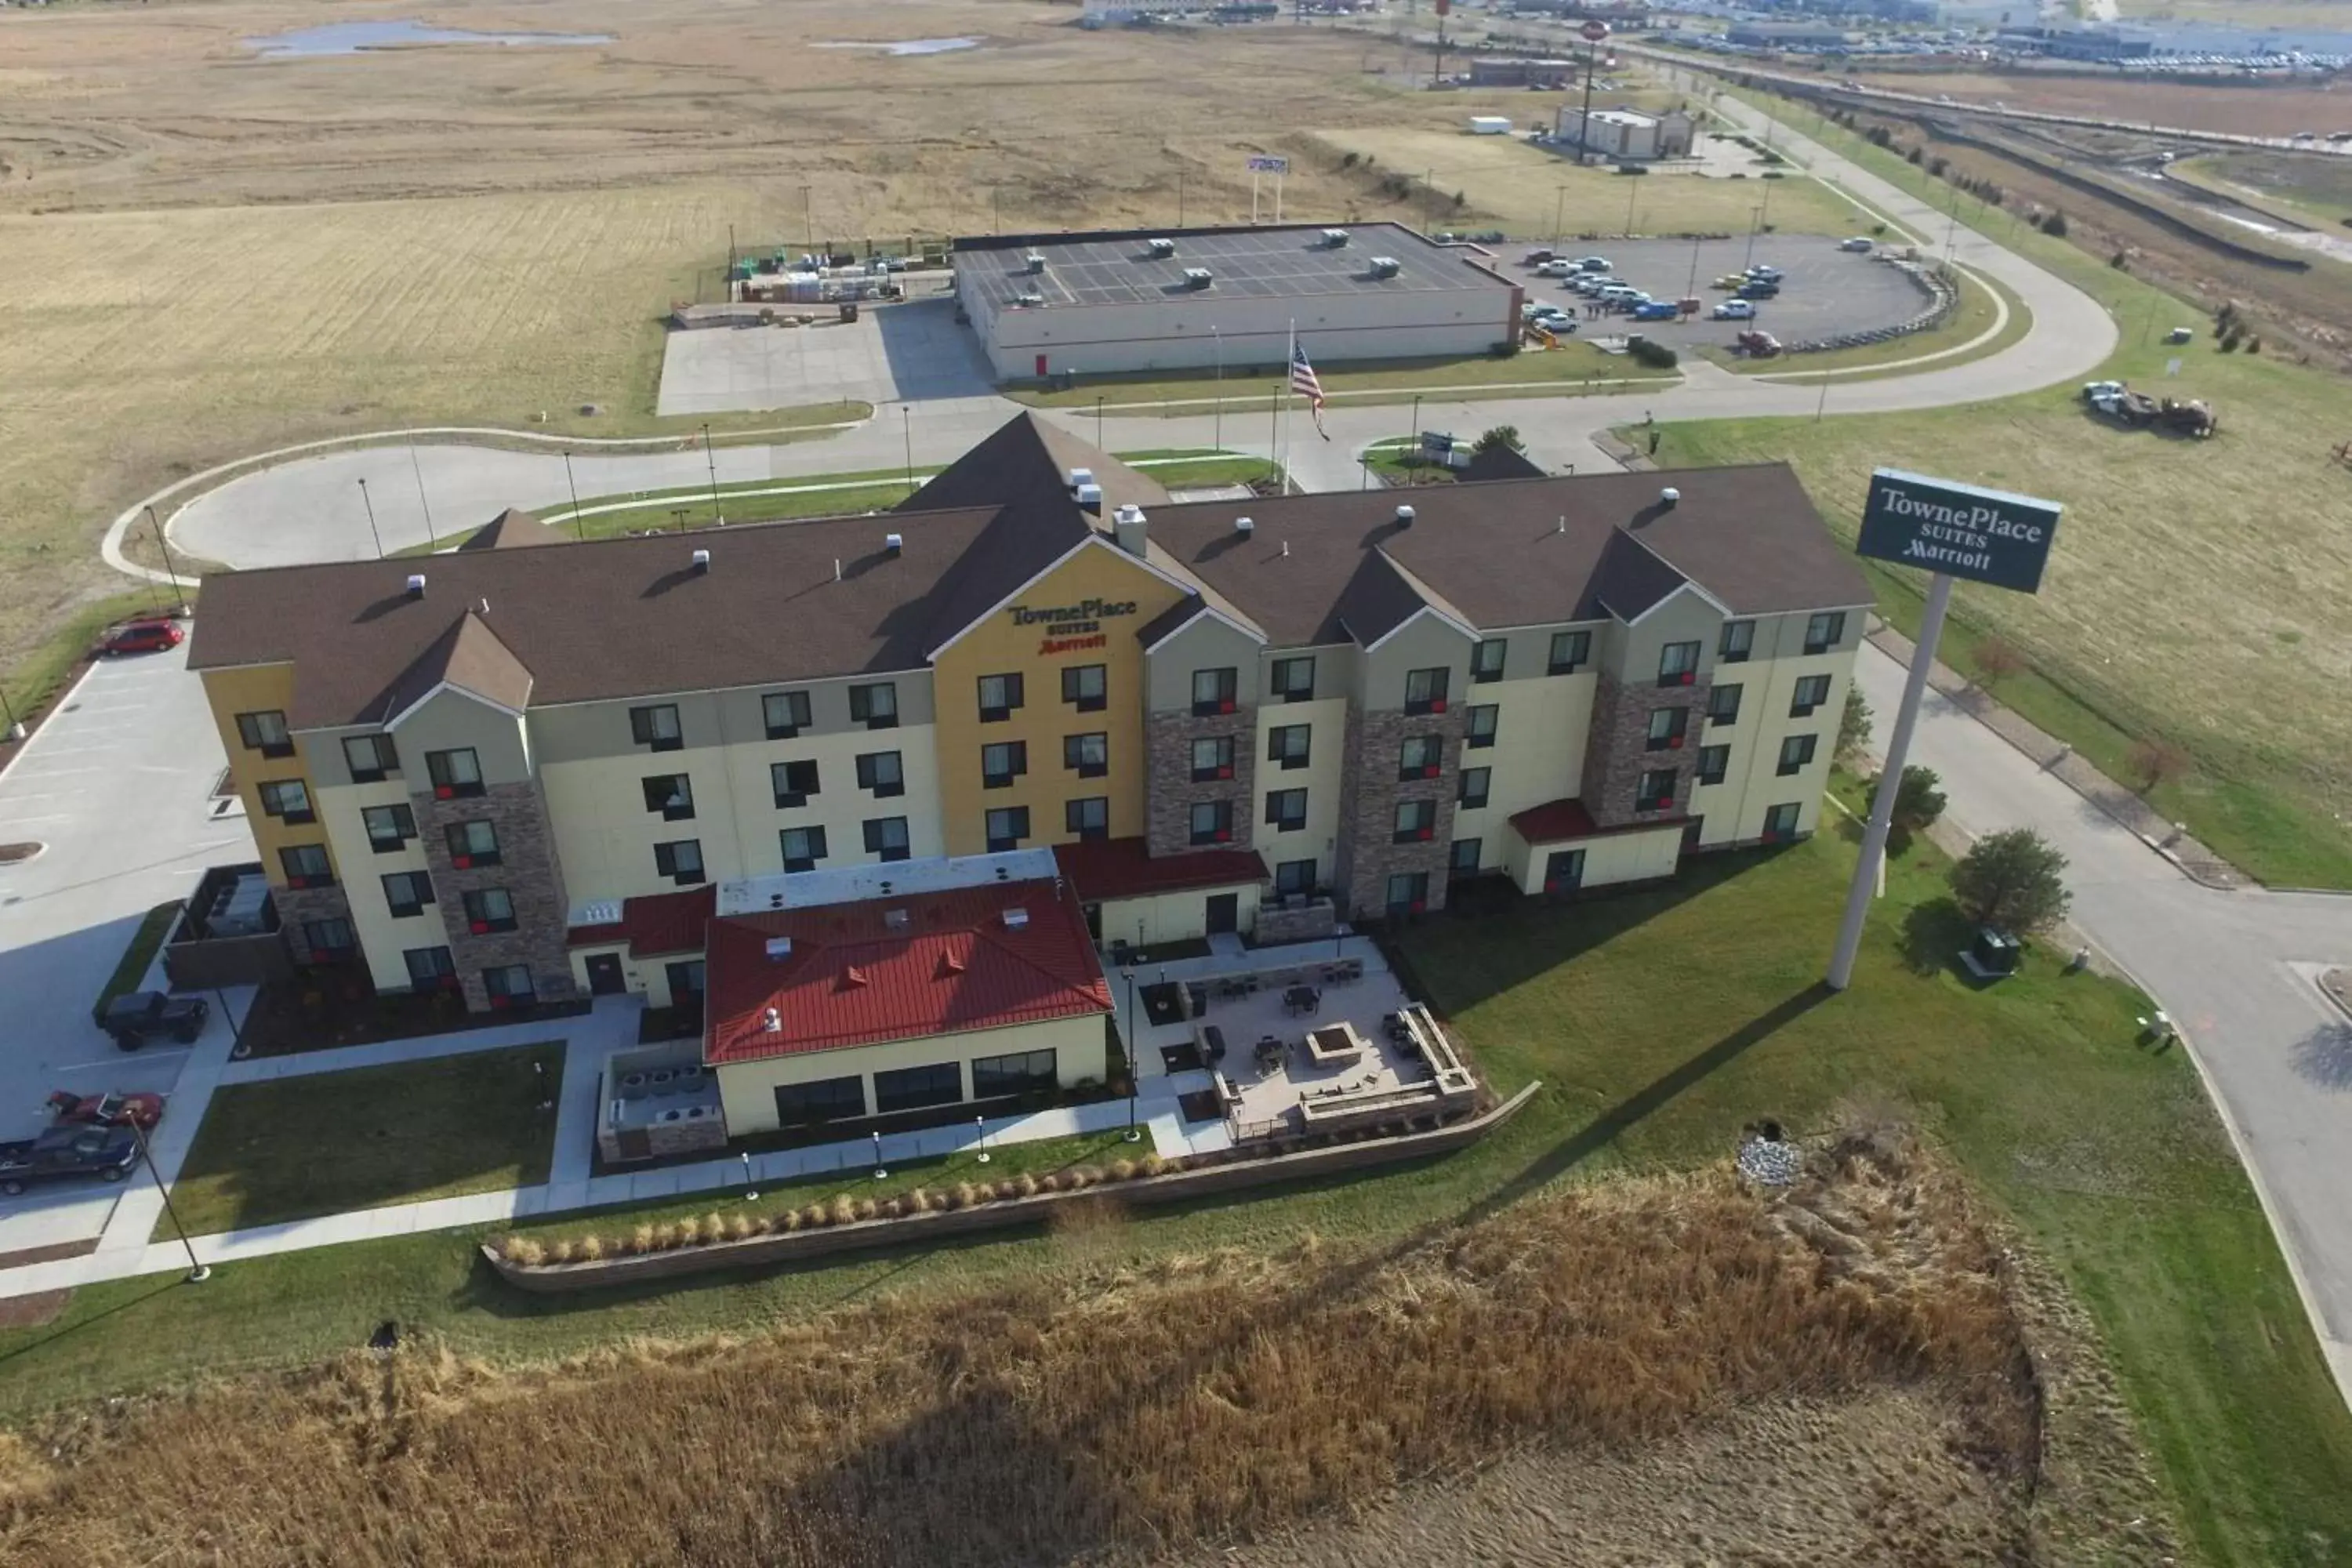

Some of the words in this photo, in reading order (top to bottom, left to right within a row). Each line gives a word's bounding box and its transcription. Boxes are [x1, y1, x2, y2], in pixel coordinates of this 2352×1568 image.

[1882, 488, 2042, 543] TownePlace
[1922, 523, 1987, 549] SUITES
[1902, 539, 1991, 570] Marriott
[1008, 598, 1137, 626] TownePlace
